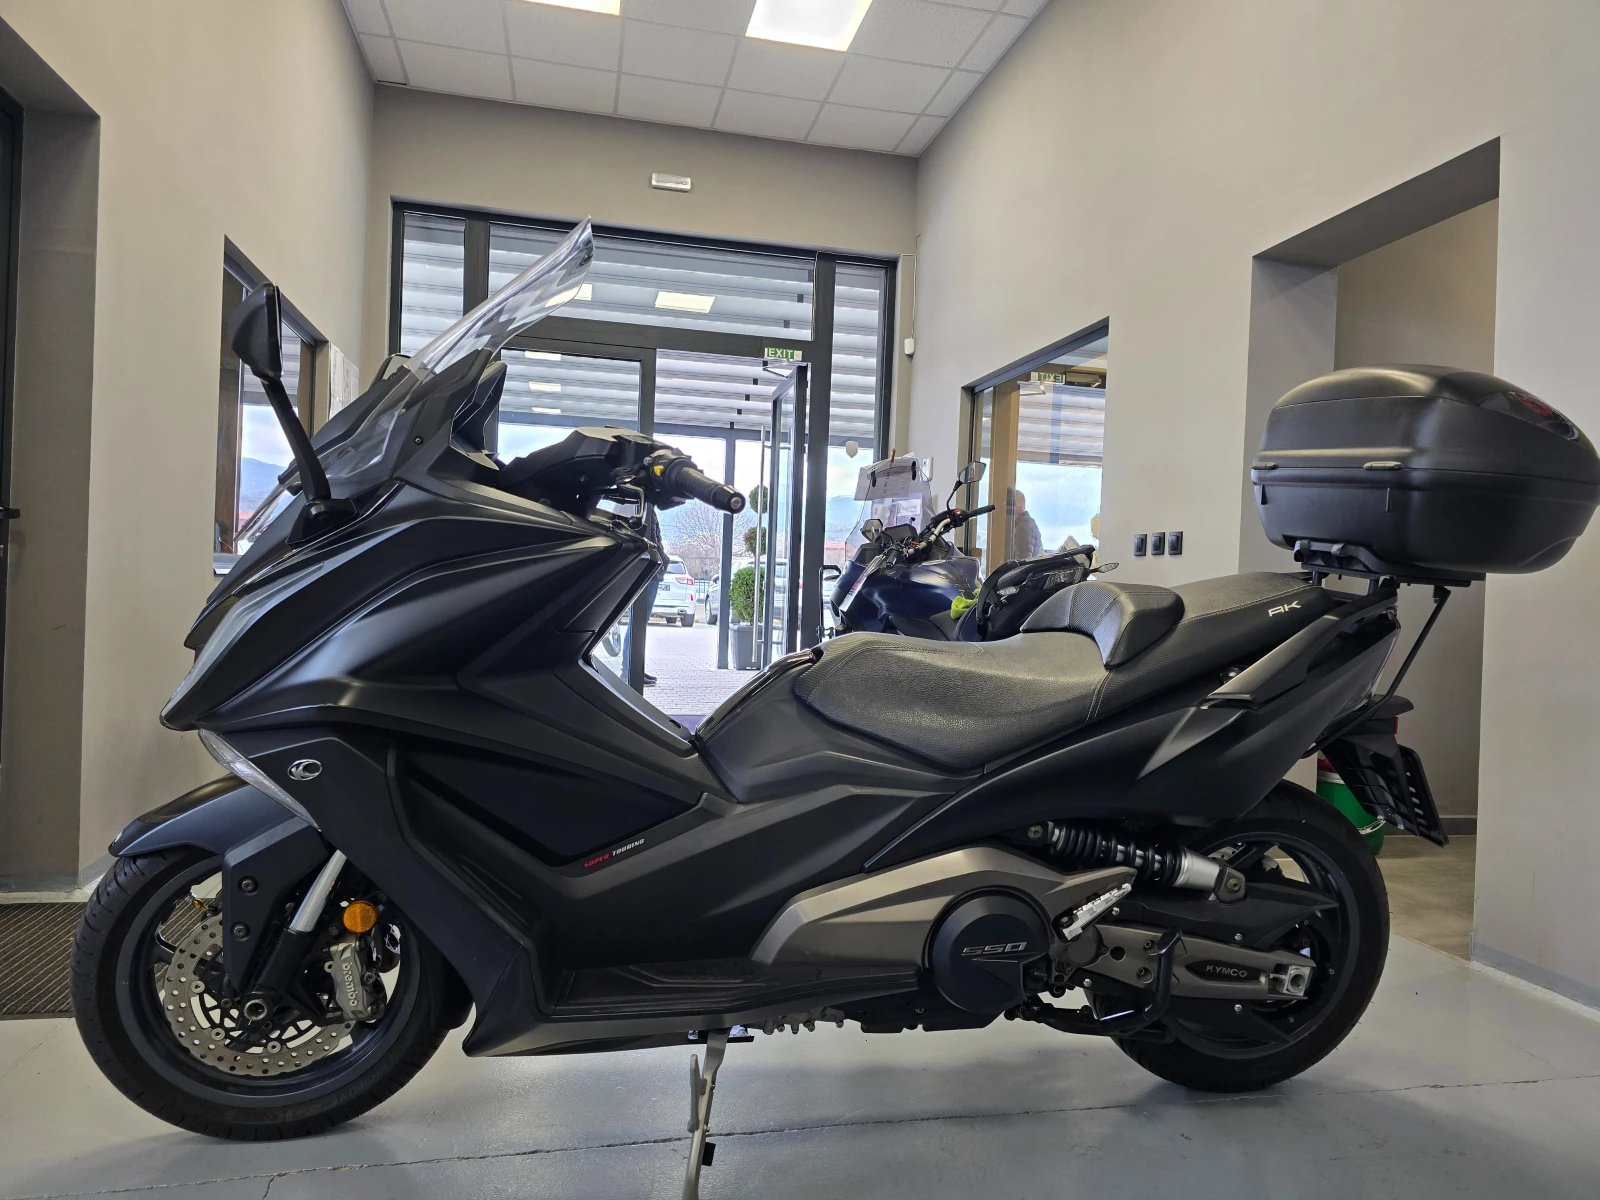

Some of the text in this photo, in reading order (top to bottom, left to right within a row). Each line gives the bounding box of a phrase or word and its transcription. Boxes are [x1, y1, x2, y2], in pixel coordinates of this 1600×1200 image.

[768, 347, 793, 359] EXIT
[1268, 600, 1301, 617] AK
[584, 838, 645, 868] SUPER TOURING
[961, 941, 1028, 956] 550
[1206, 964, 1248, 978] KYMCO
[342, 962, 359, 1007] brembo
